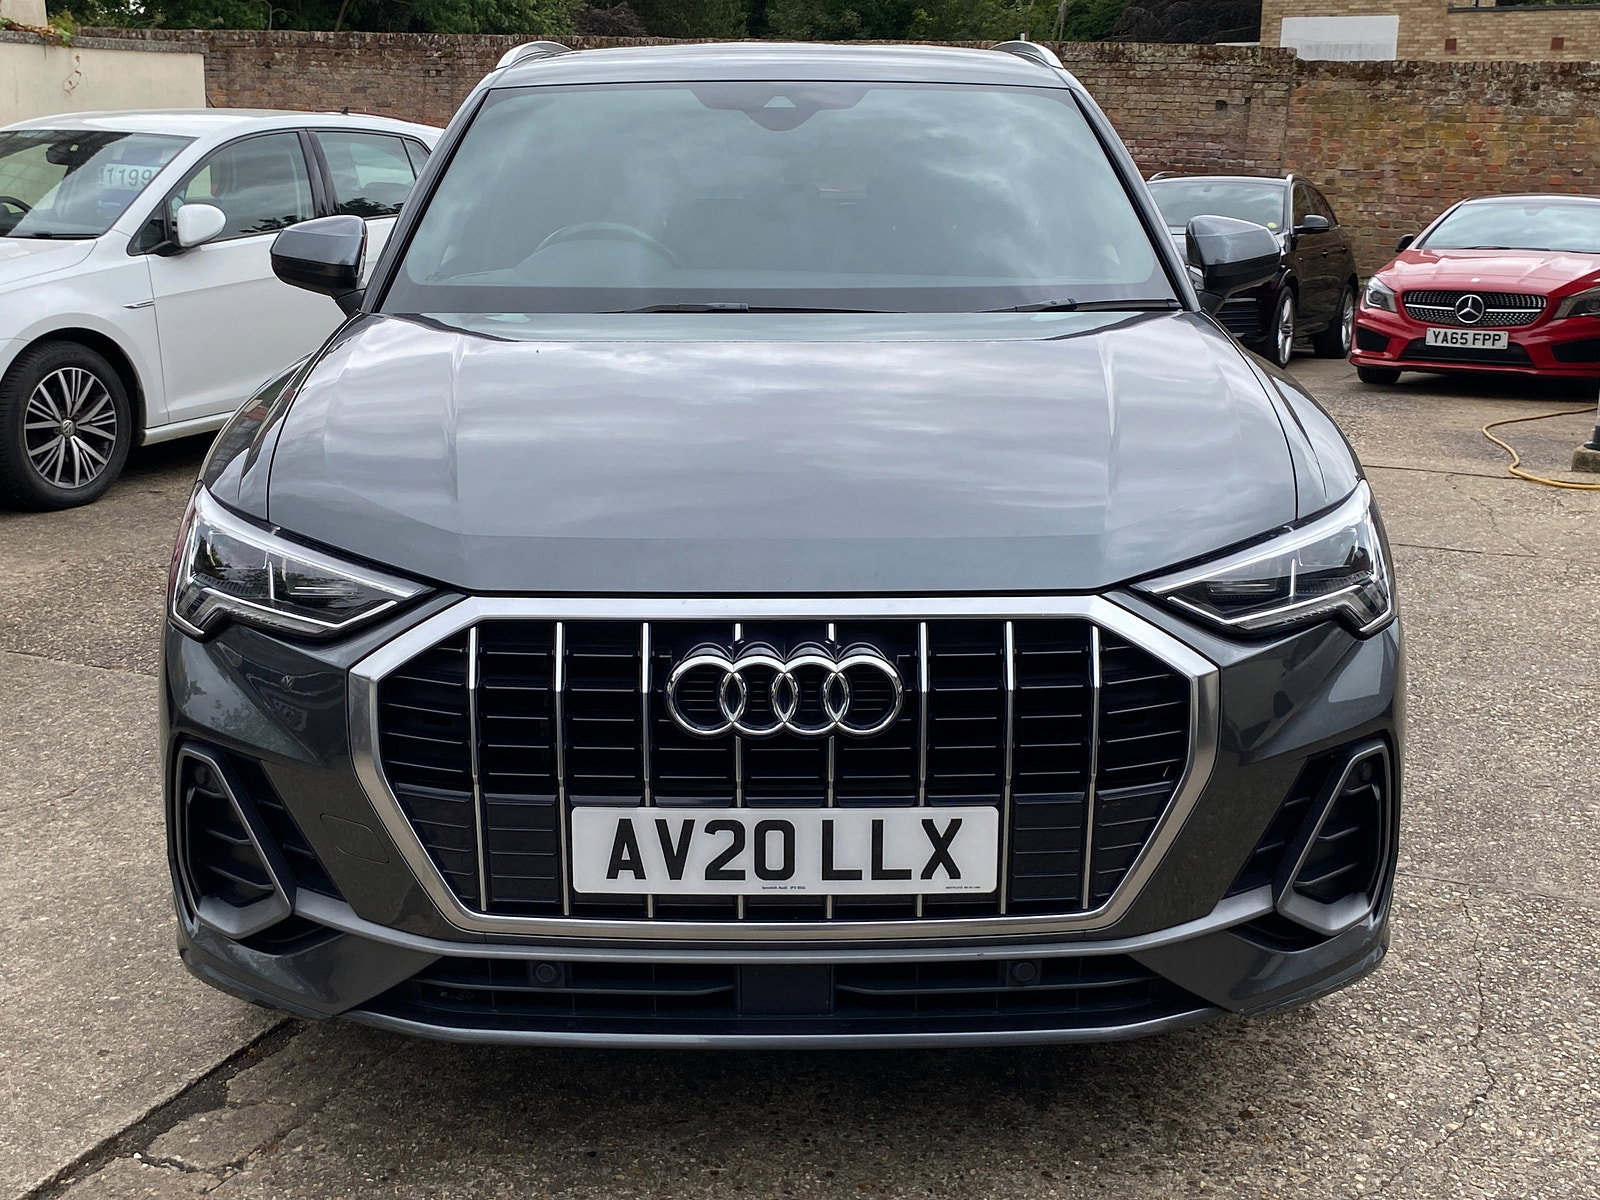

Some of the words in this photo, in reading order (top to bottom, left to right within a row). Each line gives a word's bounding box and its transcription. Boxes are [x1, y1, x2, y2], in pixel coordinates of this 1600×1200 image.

[1432, 330, 1468, 345] YA65
[1472, 333, 1501, 347] FPP
[606, 818, 796, 881] AV20
[821, 818, 963, 880] LLX
